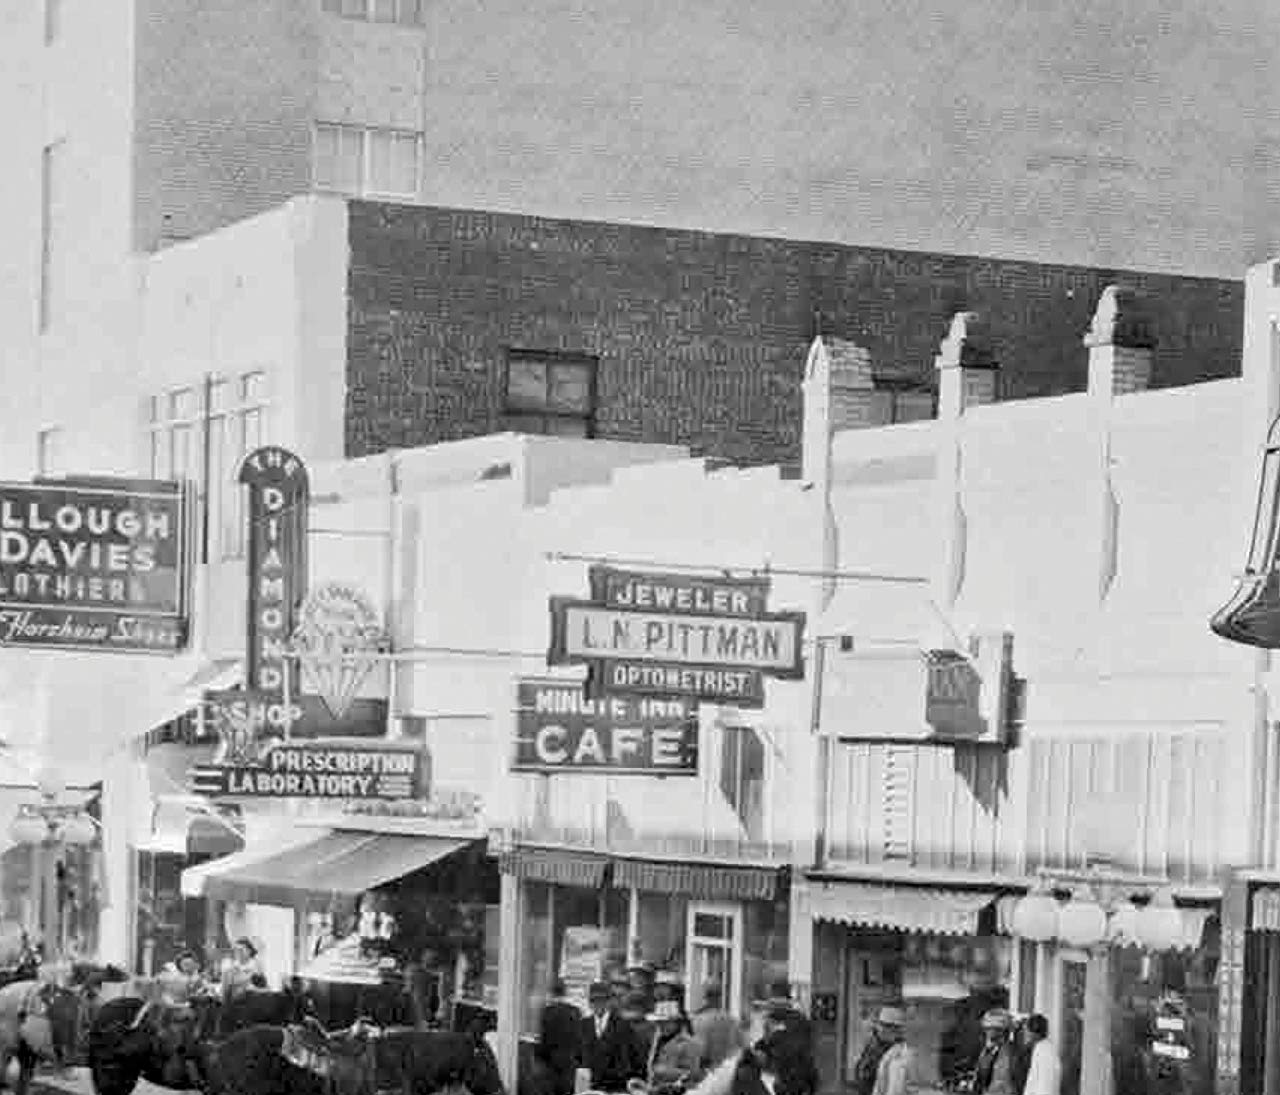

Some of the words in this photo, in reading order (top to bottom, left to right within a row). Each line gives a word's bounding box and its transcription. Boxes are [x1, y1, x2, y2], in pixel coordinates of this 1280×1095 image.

[1, 501, 170, 538] LLOUGH
[0, 530, 155, 572] DAVIES
[0, 572, 146, 602] OTHIER
[258, 487, 285, 688] DIAMOND
[614, 579, 749, 613] JEWELER
[645, 620, 780, 663] PITTMAN
[613, 666, 749, 698] OPTOMETRIST
[271, 751, 415, 774] PRESCRIPTION
[535, 726, 684, 765] CAFE
[228, 773, 372, 795] LABORATORY
